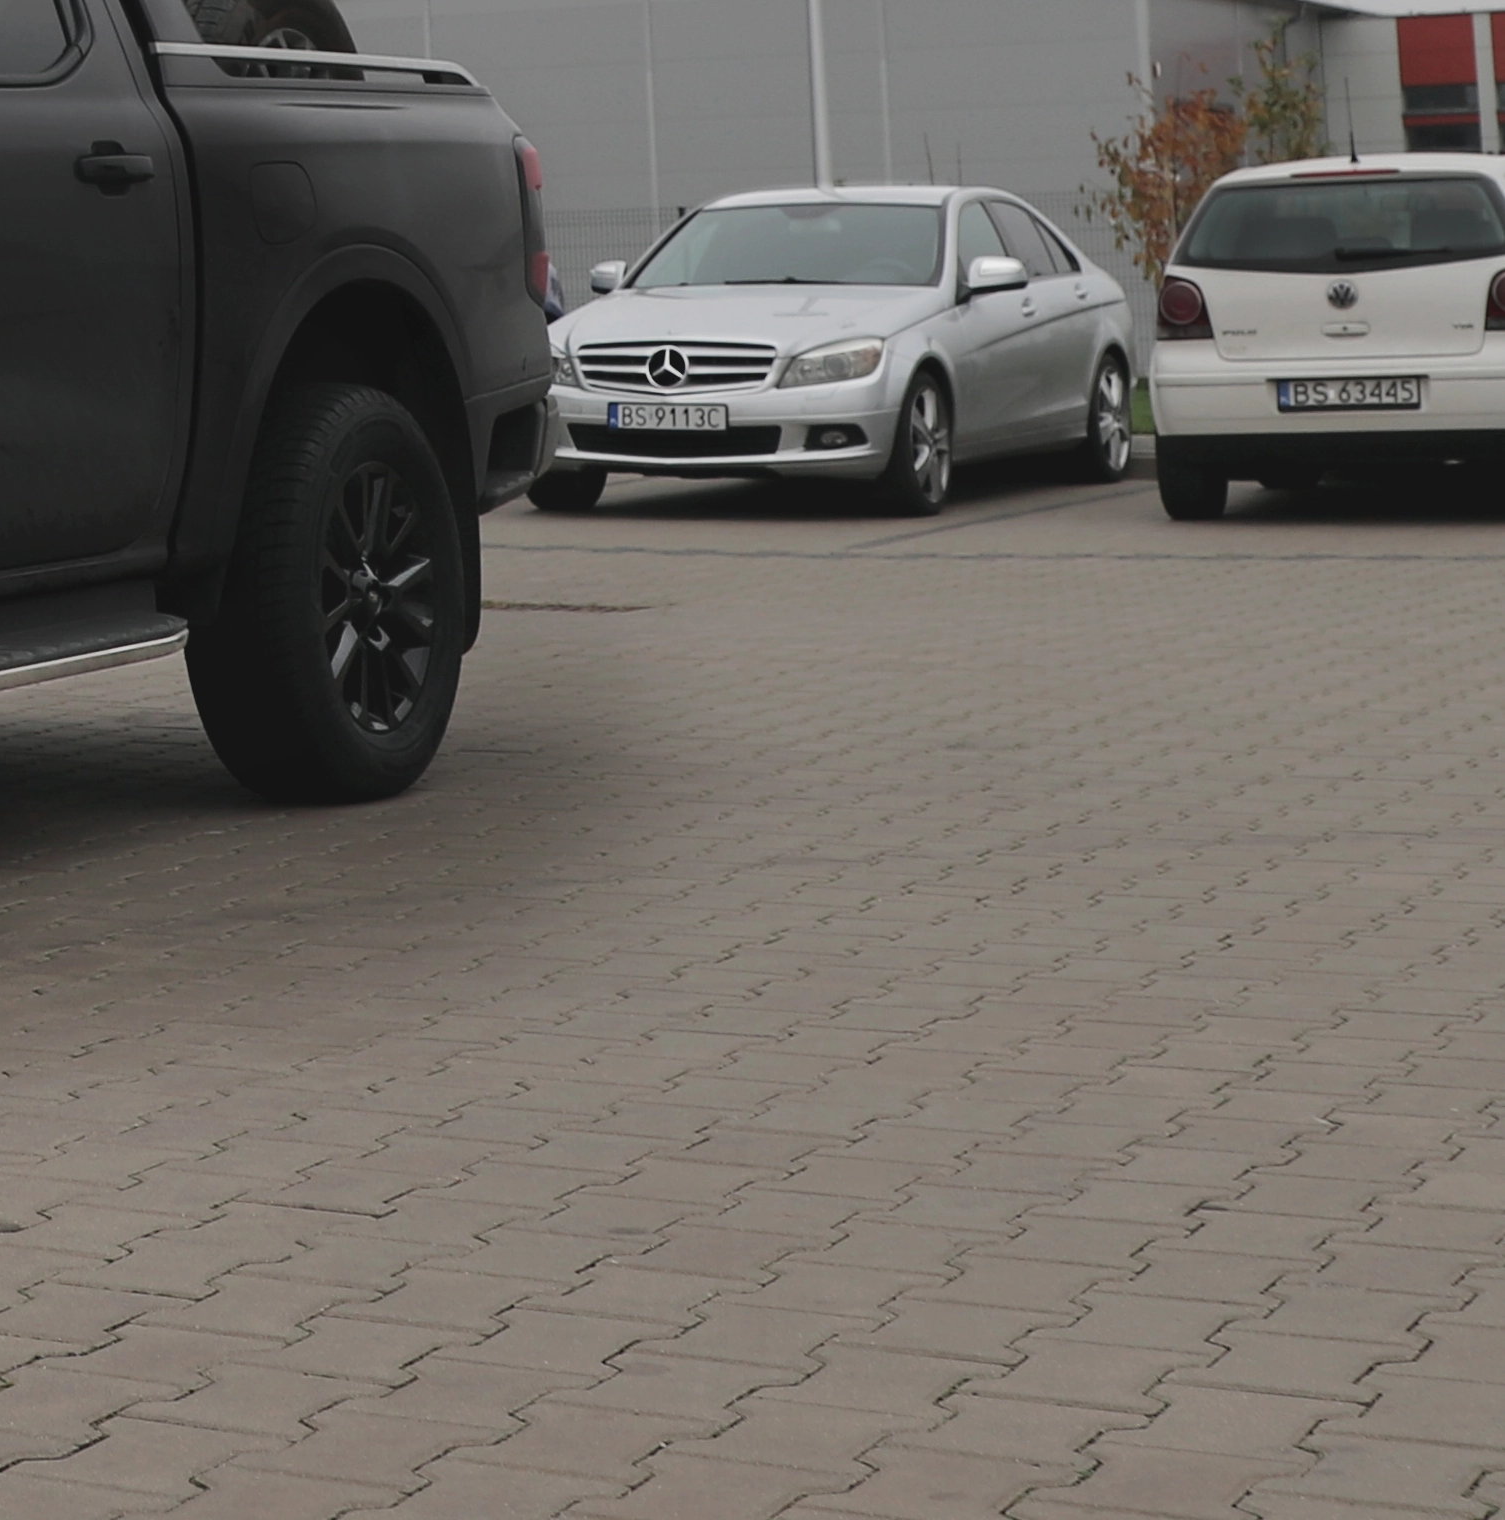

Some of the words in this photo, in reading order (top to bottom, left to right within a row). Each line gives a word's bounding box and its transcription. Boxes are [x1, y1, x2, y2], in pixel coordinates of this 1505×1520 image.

[1293, 382, 1329, 406] BS
[1339, 381, 1414, 403] 63445
[621, 406, 647, 427] BS
[655, 406, 720, 428] 9113C
